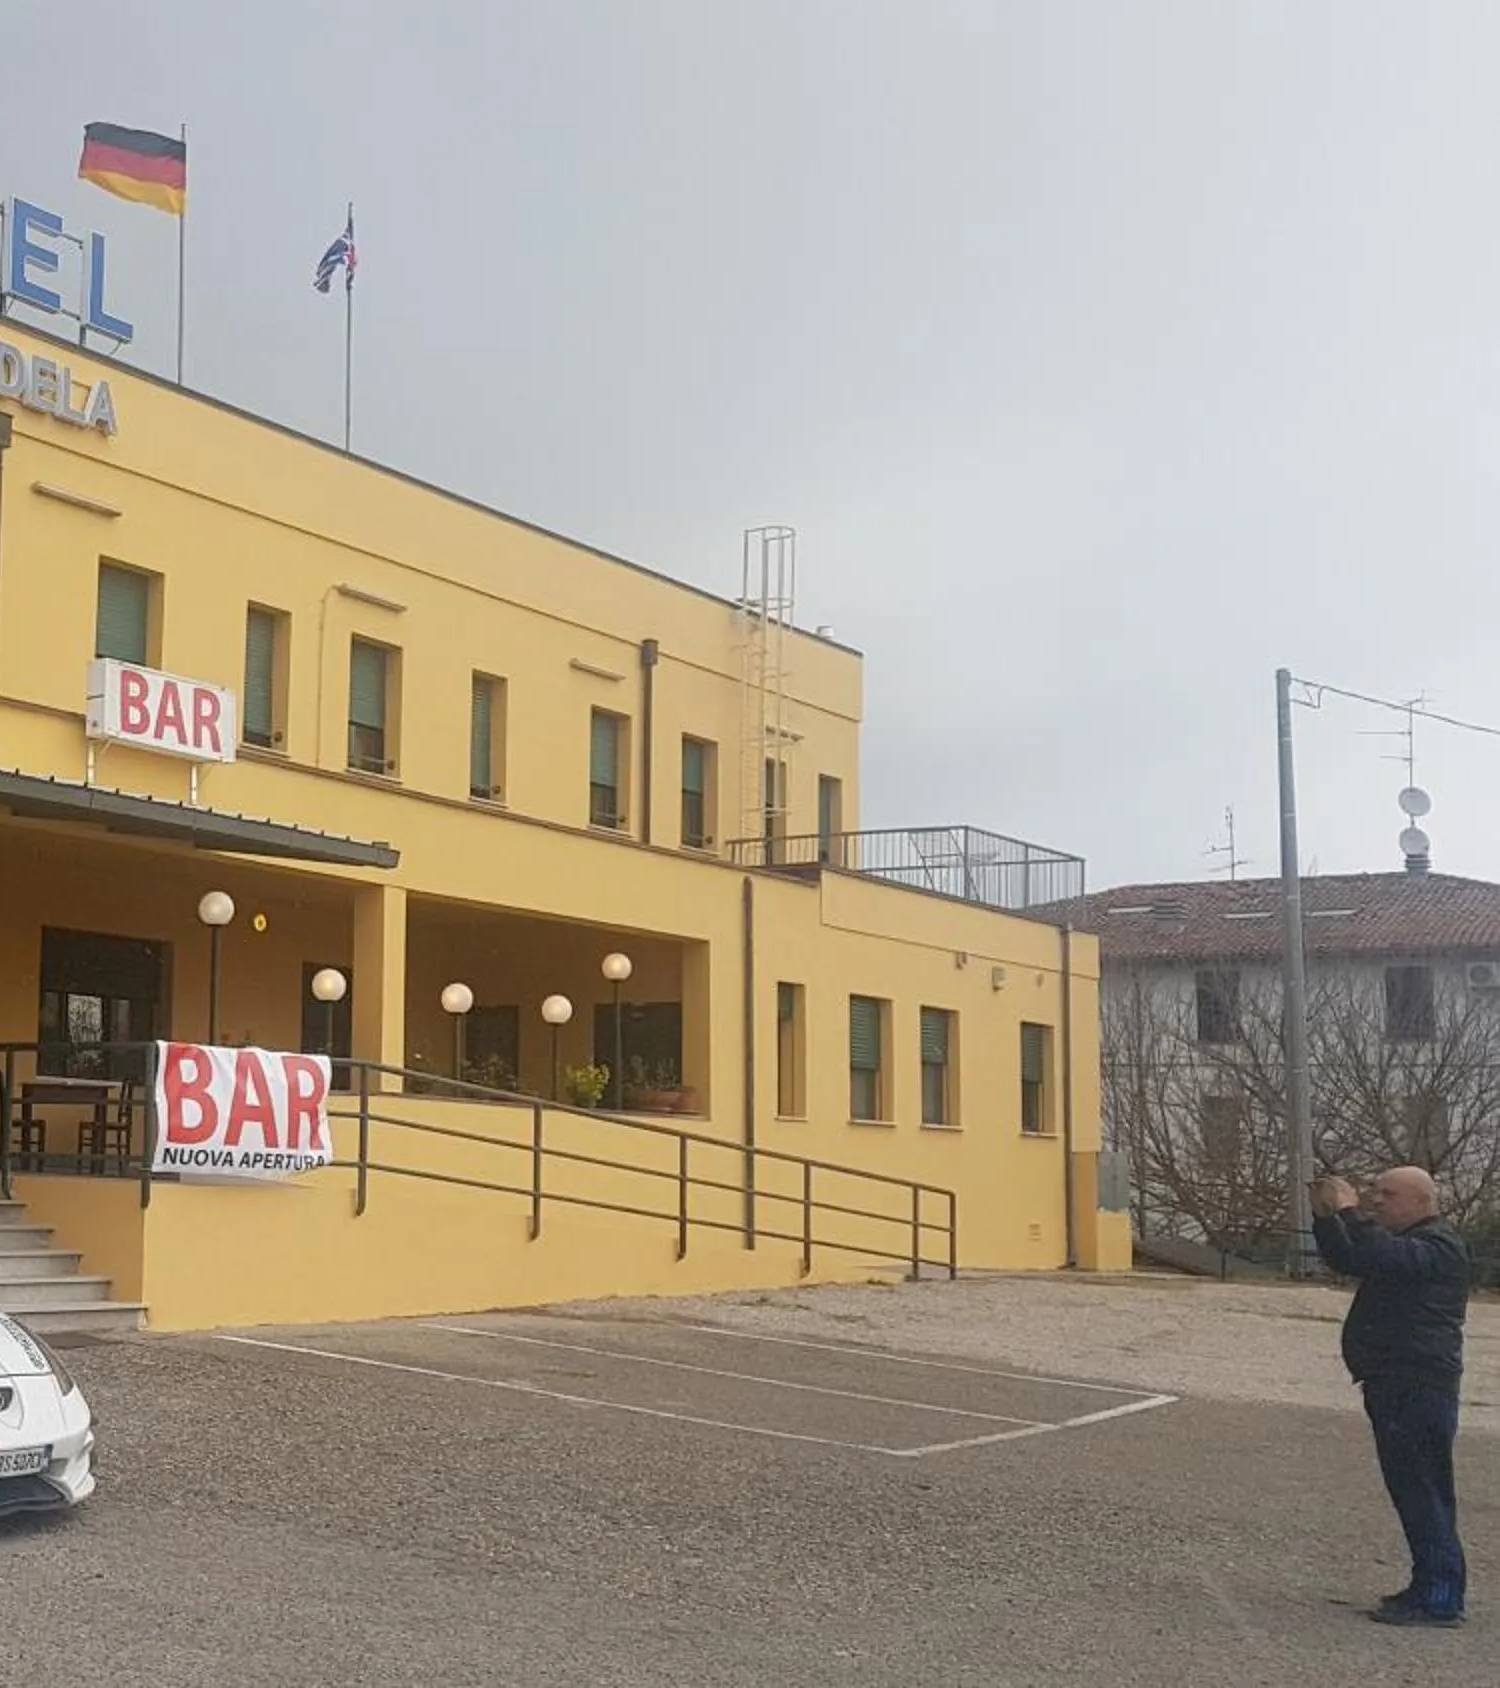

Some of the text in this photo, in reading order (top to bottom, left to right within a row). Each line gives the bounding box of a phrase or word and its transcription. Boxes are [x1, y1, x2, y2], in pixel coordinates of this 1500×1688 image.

[120, 670, 222, 753] BAR
[164, 1044, 325, 1150] BAR
[162, 1147, 325, 1171] NUOVA APERTURA
